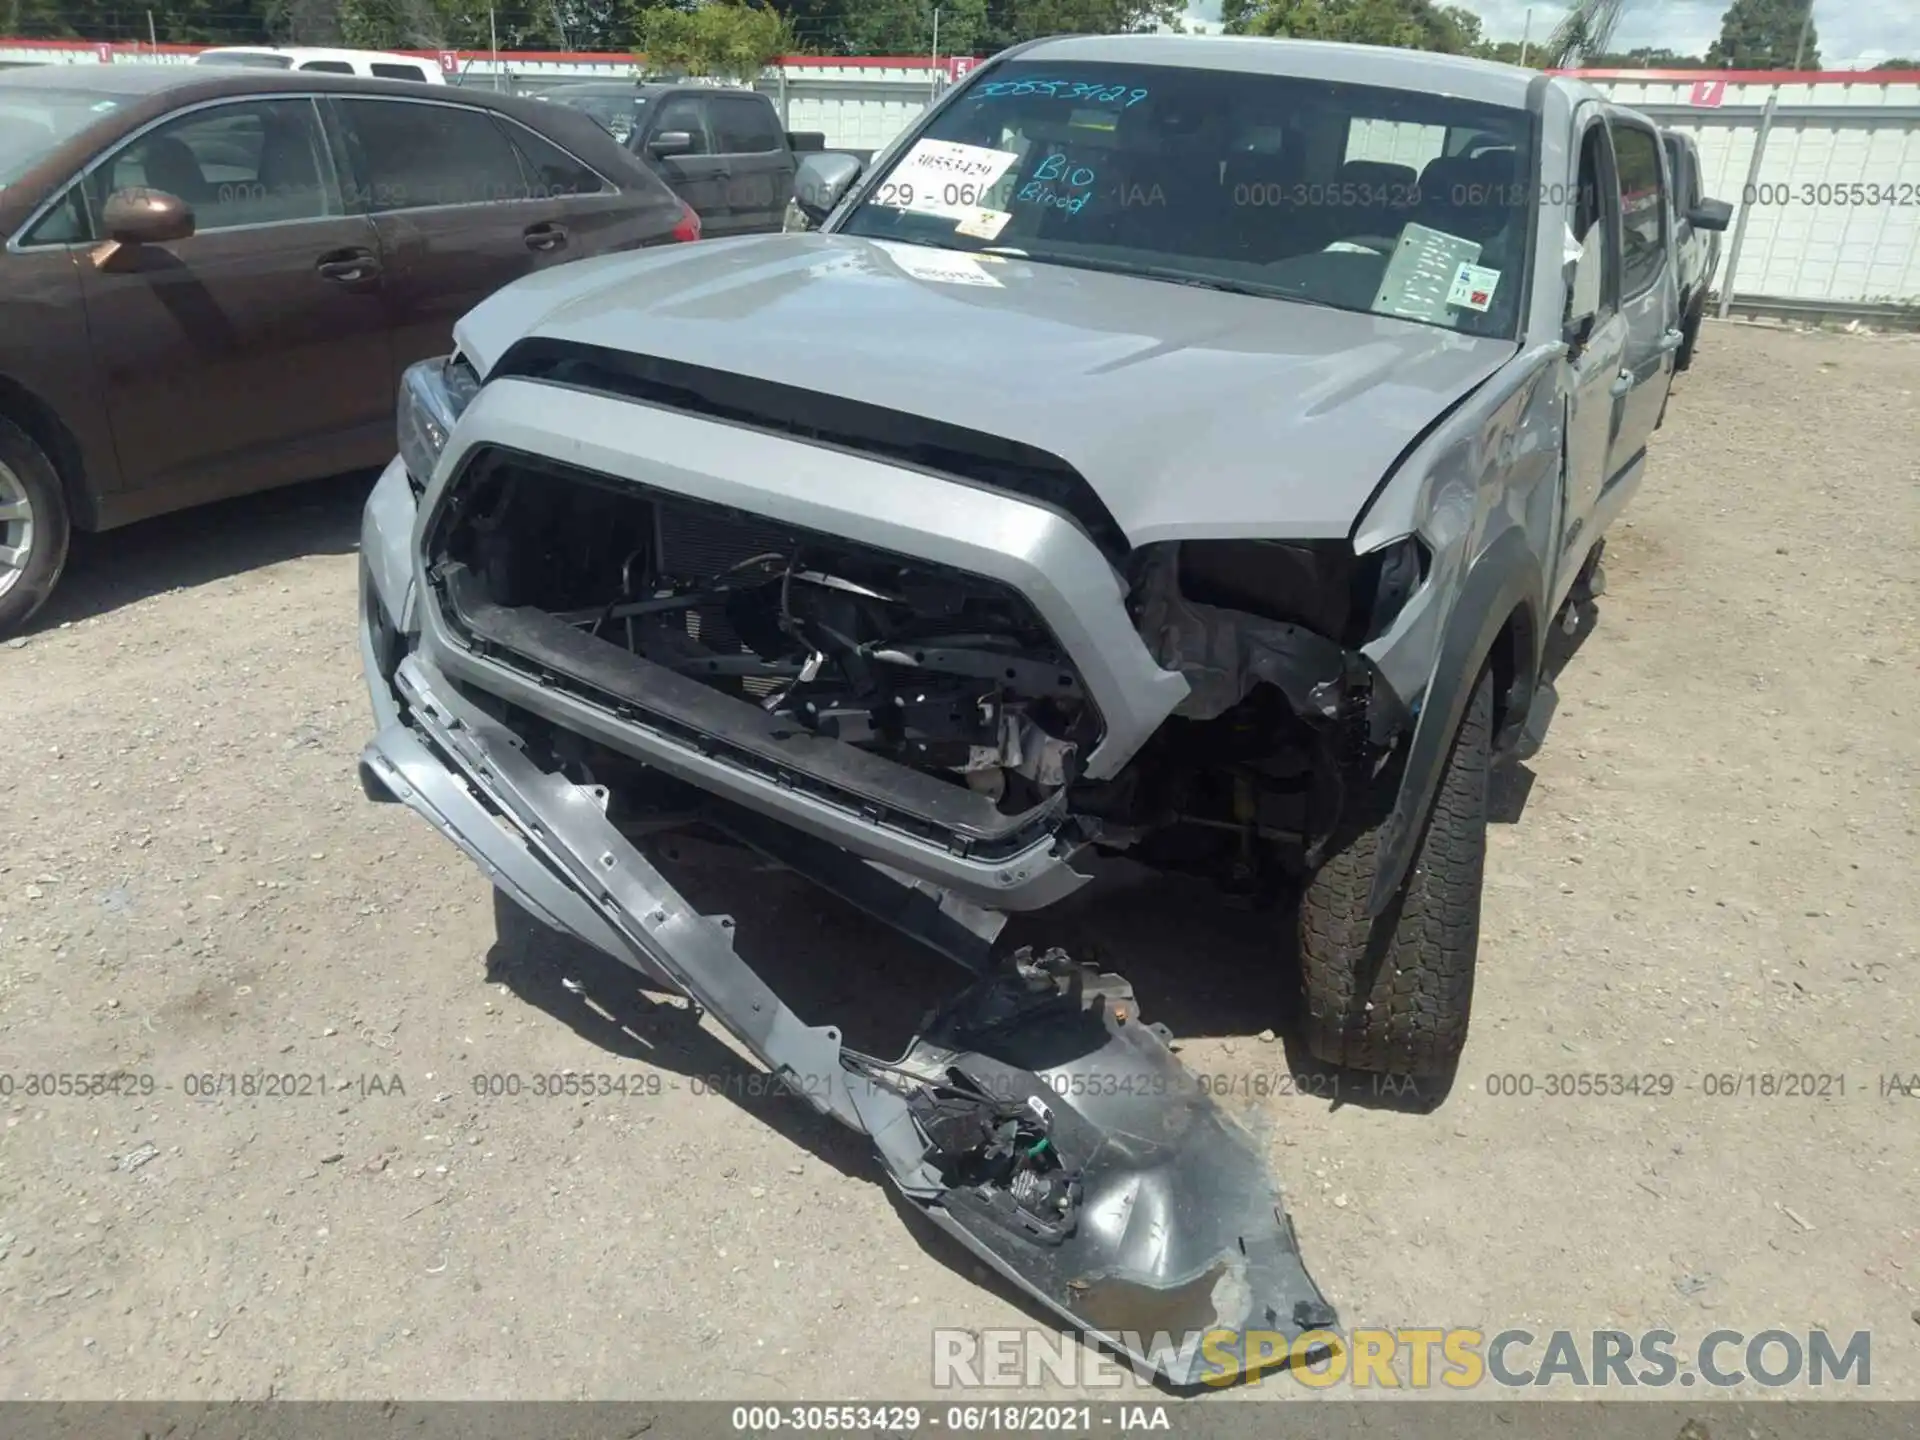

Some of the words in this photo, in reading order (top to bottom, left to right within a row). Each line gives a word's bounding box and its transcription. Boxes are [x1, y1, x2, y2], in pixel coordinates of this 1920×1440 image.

[443, 54, 454, 70] 3
[956, 60, 967, 79] 5
[1702, 80, 1717, 102] 7
